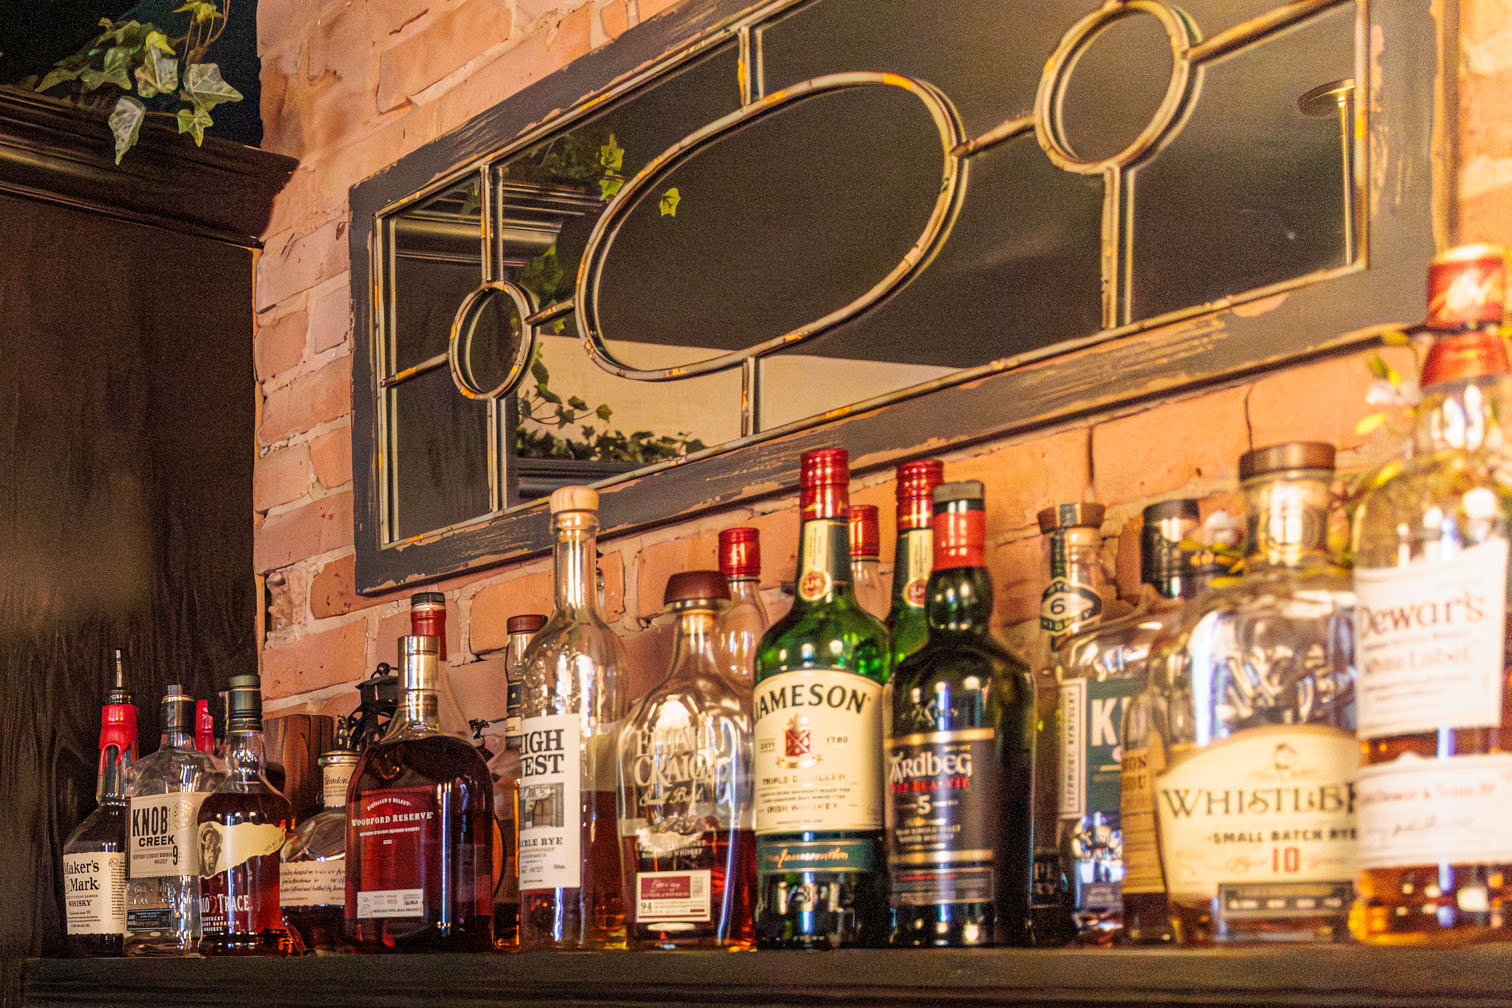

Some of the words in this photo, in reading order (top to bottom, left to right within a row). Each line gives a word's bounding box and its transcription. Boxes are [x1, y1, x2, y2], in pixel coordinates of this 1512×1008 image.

[1359, 591, 1484, 639] Dewar's
[754, 683, 867, 722] JAMESON
[635, 756, 709, 787] CRAIG
[890, 751, 974, 784] Ardbeg
[917, 794, 931, 815] 5
[132, 806, 168, 837] KNOB
[351, 816, 390, 827] WOODFORD
[392, 812, 433, 823] RESERVE
[139, 835, 175, 847] CREEK
[541, 837, 563, 846] RYE
[1213, 832, 1263, 844] SMALL
[1271, 829, 1322, 841] BATCH
[172, 845, 179, 865] 9
[1272, 847, 1300, 873] 10
[70, 877, 99, 891] Mark
[217, 894, 250, 914] TRACE
